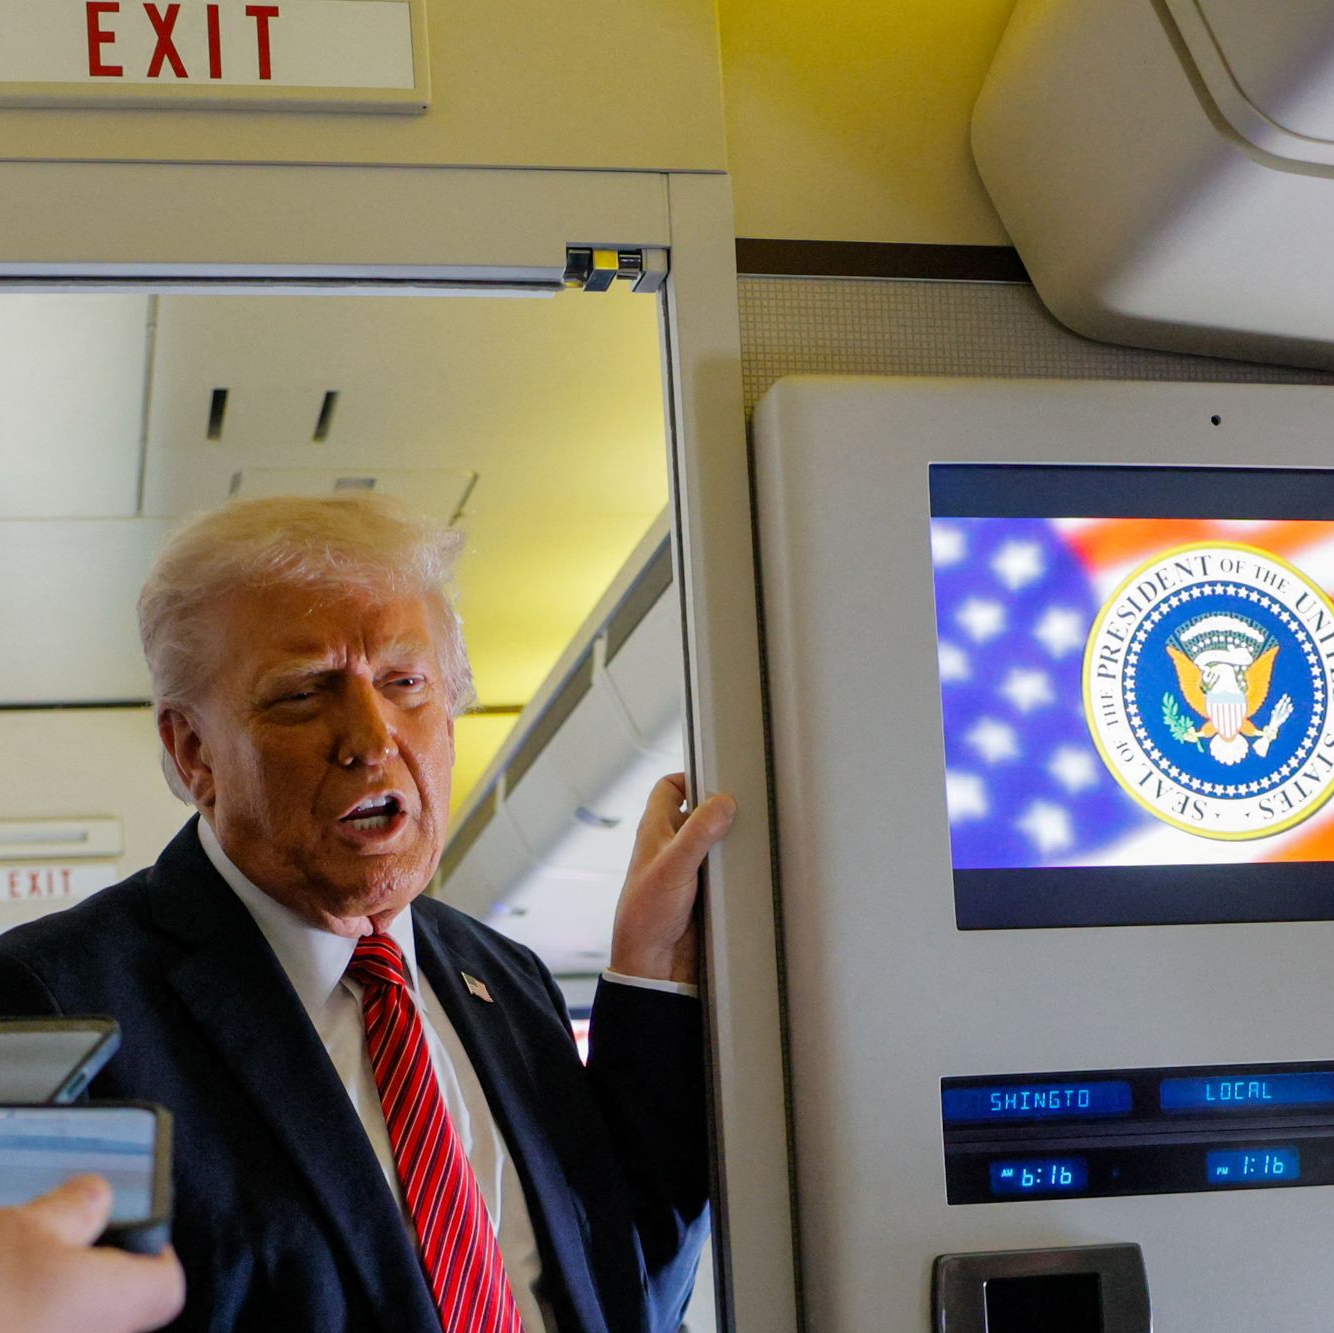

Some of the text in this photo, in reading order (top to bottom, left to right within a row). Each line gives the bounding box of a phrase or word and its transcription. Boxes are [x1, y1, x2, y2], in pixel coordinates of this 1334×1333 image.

[85, 1, 280, 80] EXIT
[1219, 557, 1245, 574] OF
[1252, 563, 1290, 594] THE
[1097, 554, 1212, 680] PRESIDENT
[1100, 687, 1119, 726] THE
[1115, 739, 1135, 763] OF
[1138, 762, 1208, 821] SEAL
[7, 868, 73, 899] EXIT
[990, 1089, 1089, 1111] SHINGTO
[1206, 1081, 1272, 1101] LOCAL
[1001, 1168, 1014, 1178] AM
[1216, 1166, 1229, 1176] PM
